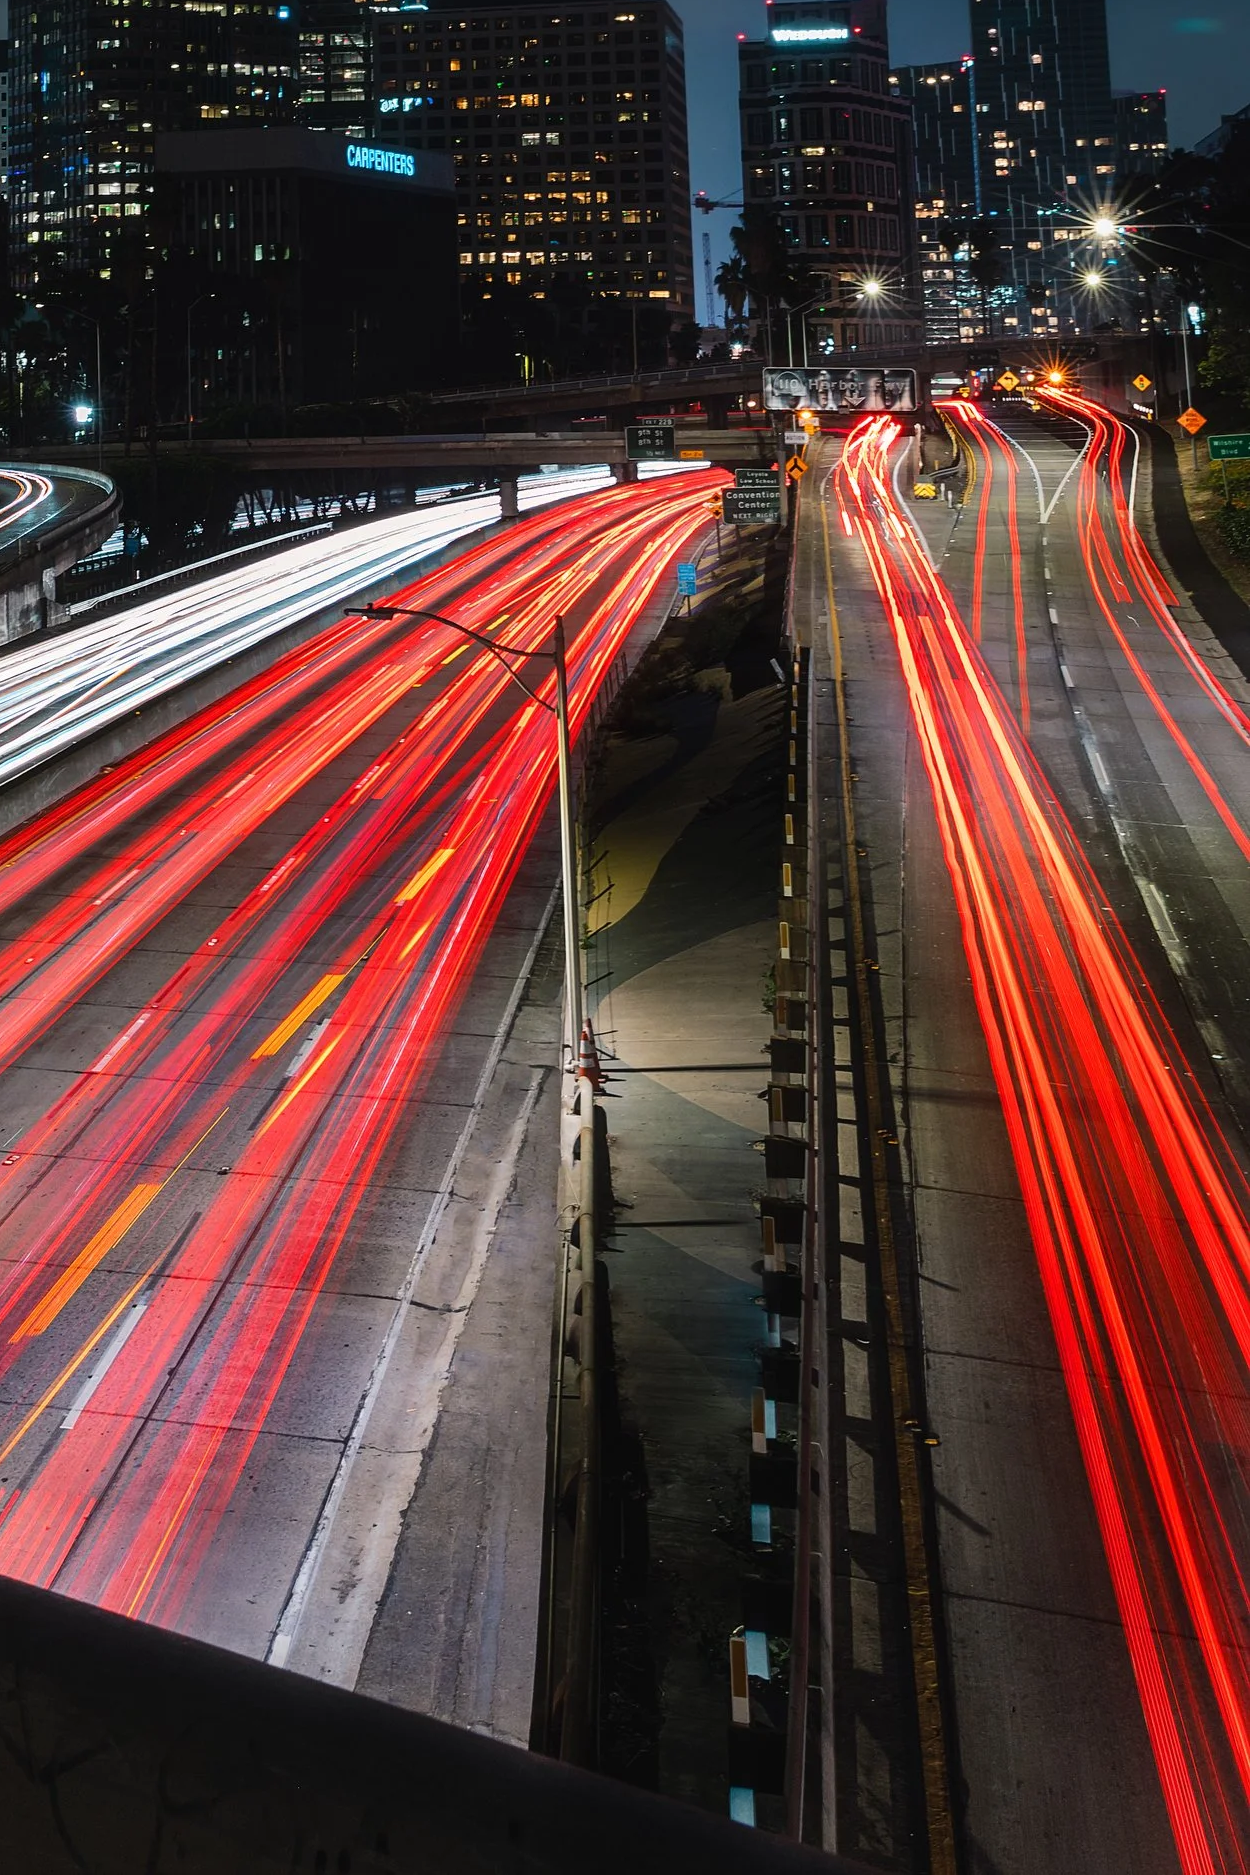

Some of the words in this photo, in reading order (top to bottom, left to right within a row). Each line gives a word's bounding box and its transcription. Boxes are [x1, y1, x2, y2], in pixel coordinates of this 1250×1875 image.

[346, 144, 416, 176] CARPENTERS
[779, 379, 800, 390] 110
[809, 379, 865, 391] Harbor
[875, 380, 906, 393] Fwy
[638, 429, 651, 437] 9th
[726, 491, 781, 499] Convention
[738, 501, 771, 509] Center
